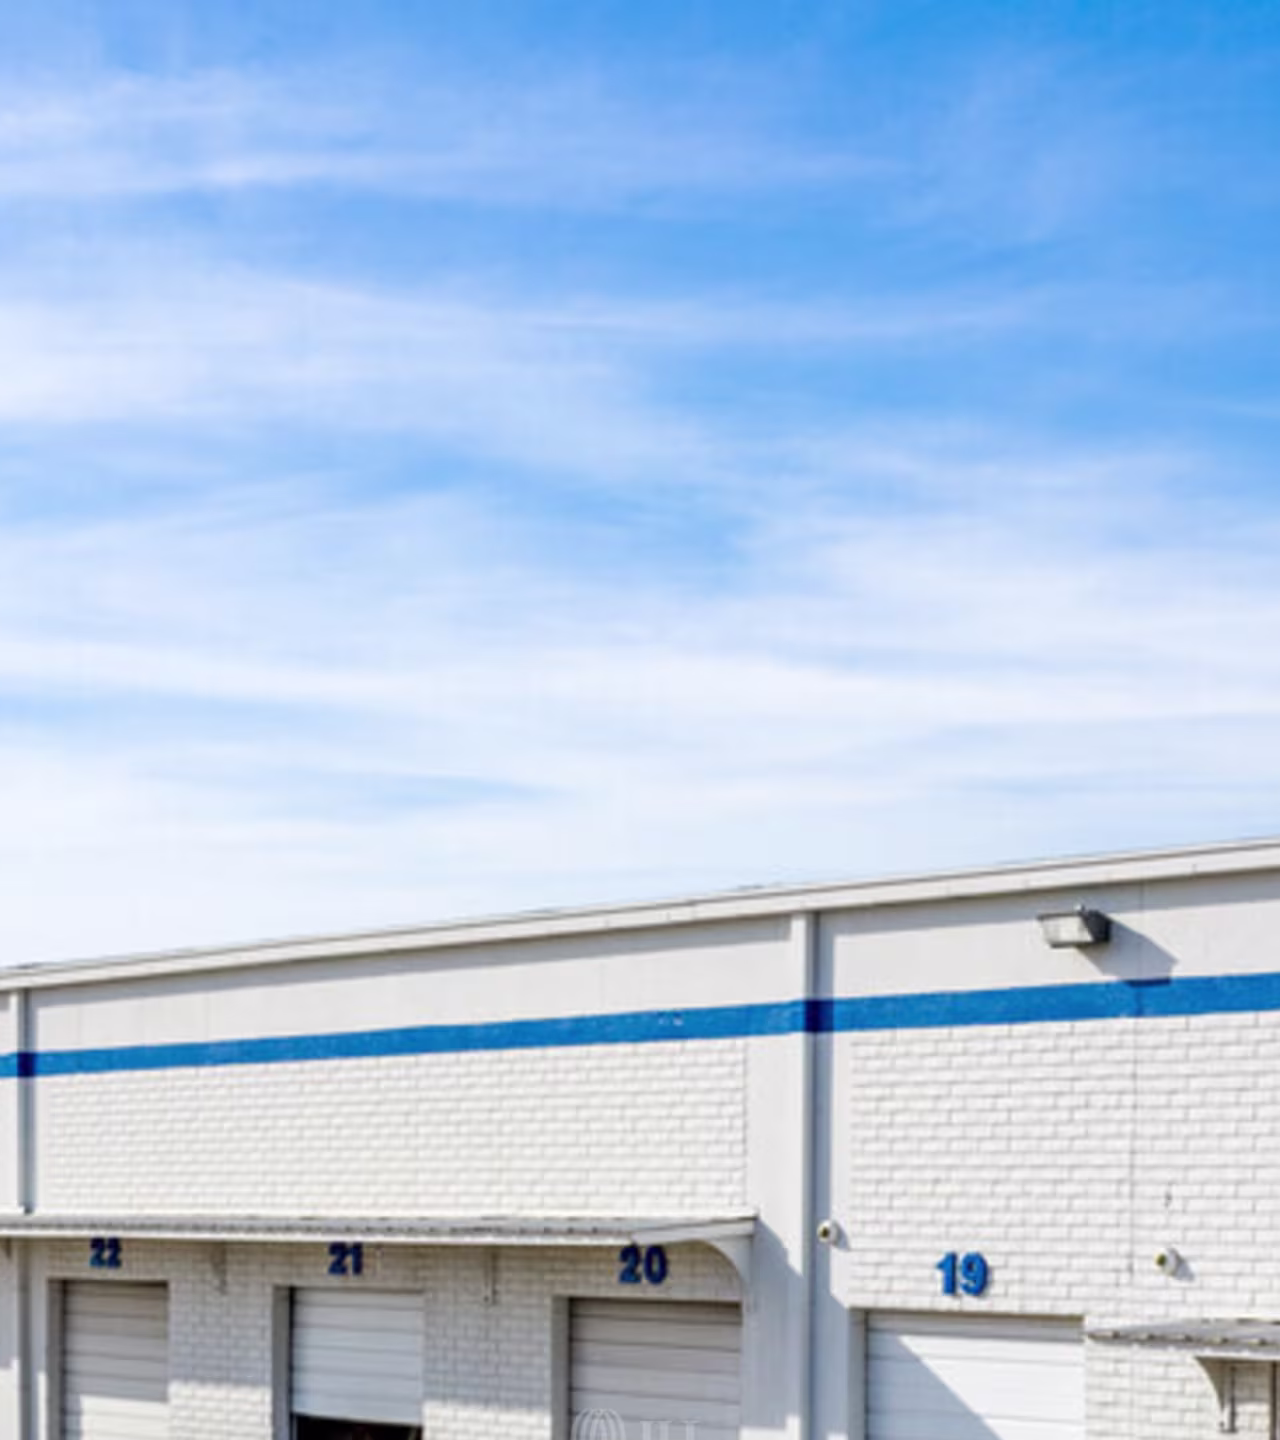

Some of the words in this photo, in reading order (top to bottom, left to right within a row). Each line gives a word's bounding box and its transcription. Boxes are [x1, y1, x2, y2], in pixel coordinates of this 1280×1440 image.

[89, 1237, 122, 1268] 22
[328, 1243, 364, 1275] 21
[618, 1245, 668, 1285] 20
[935, 1251, 990, 1297] 19
